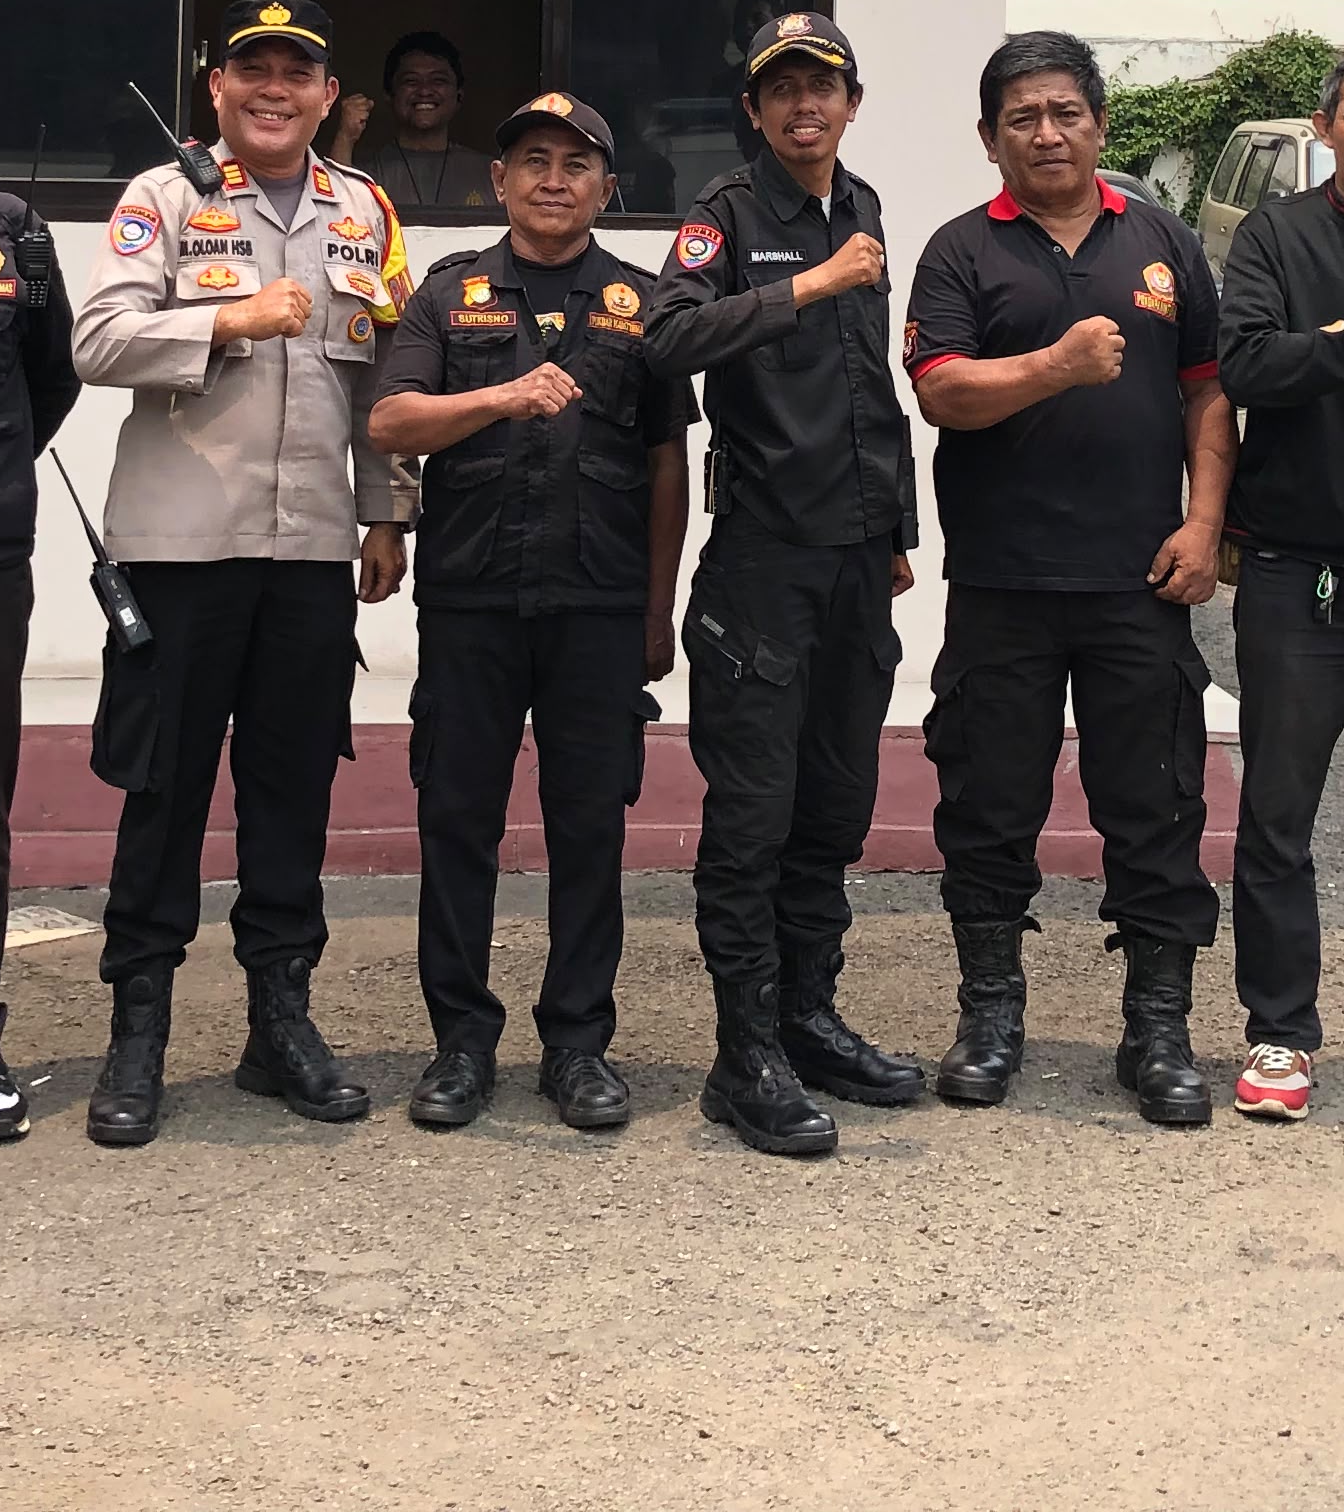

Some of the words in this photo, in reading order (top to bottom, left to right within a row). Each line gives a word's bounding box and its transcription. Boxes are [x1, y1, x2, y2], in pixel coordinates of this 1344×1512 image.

[327, 243, 379, 267] POLRI
[751, 251, 804, 262] MARSHALL
[458, 314, 509, 323] SUTRISNO
